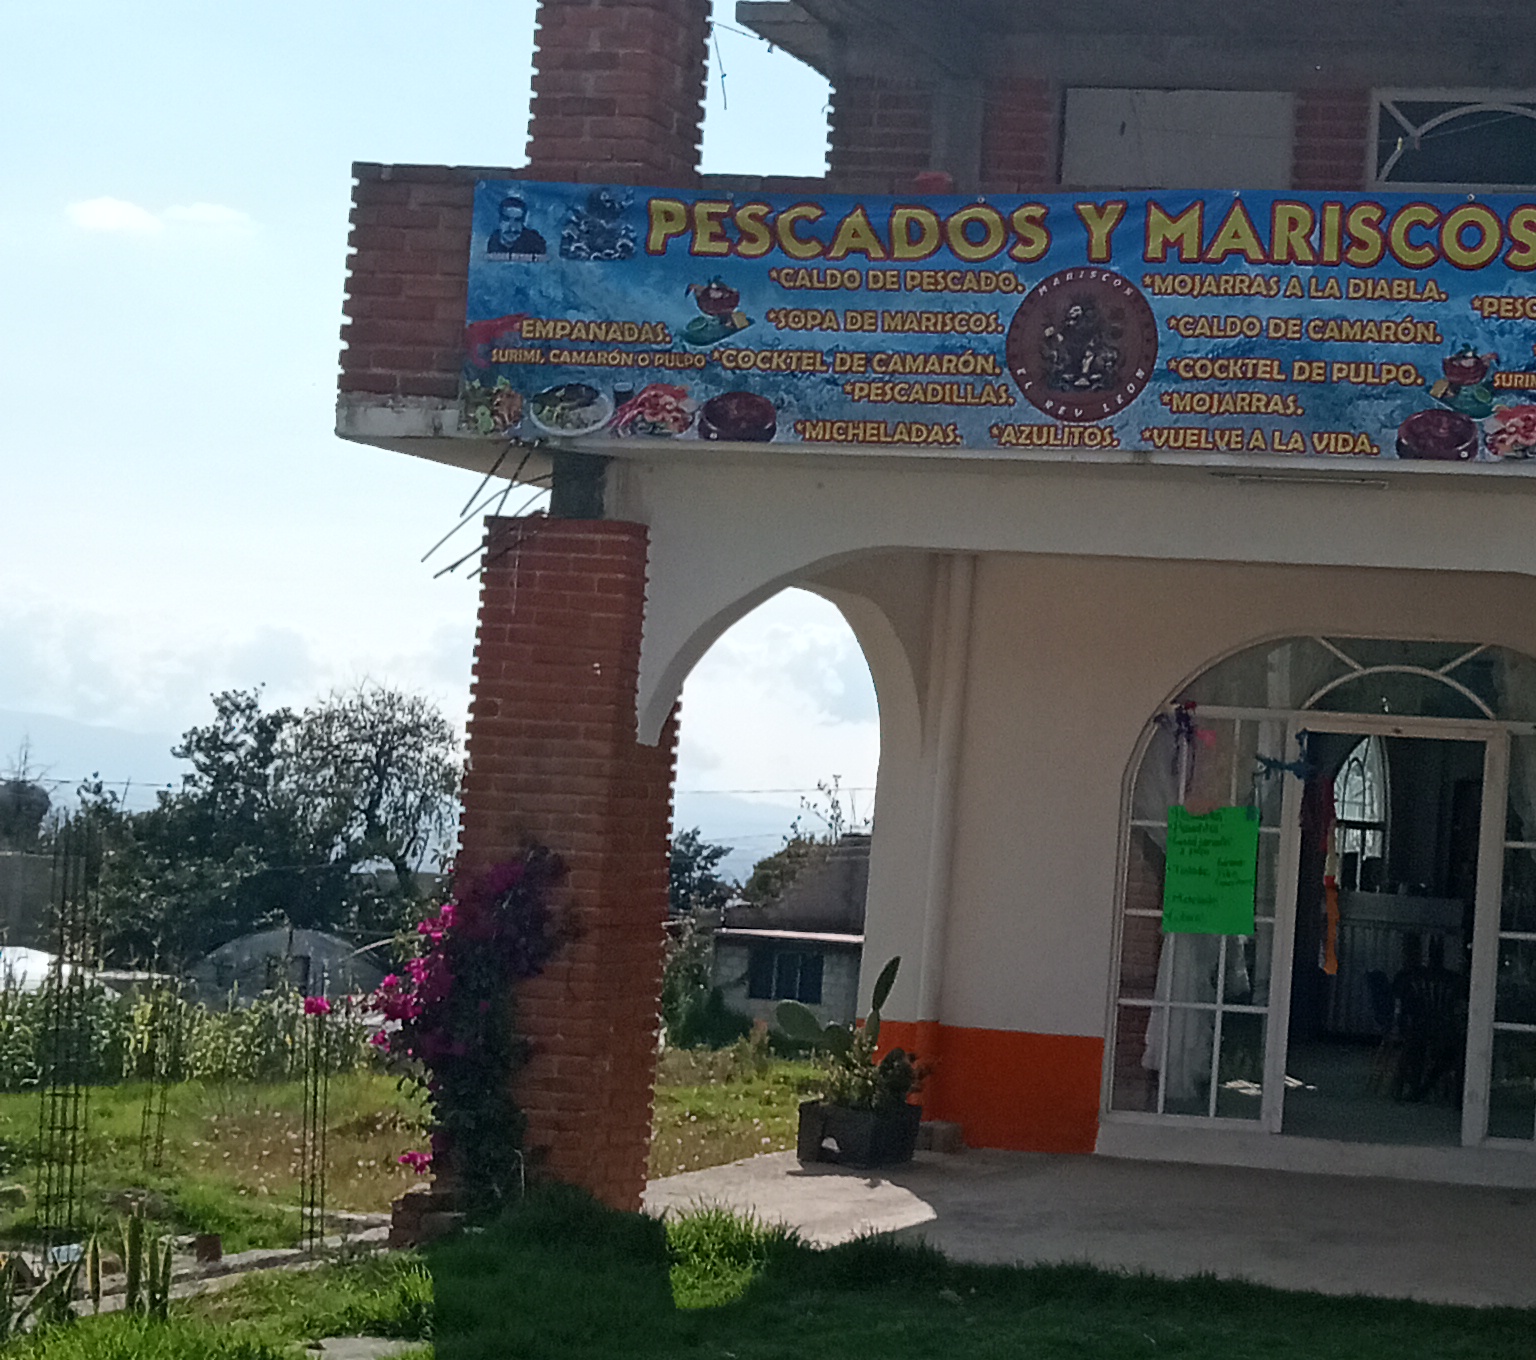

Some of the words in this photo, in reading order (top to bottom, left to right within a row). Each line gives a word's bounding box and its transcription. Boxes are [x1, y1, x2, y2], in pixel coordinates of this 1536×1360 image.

[646, 198, 1053, 262] PESCADOS
[1074, 201, 1128, 262] Y
[867, 270, 900, 290] DE
[905, 270, 1025, 293] PESCADO.
[1284, 276, 1304, 298] A
[1309, 277, 1343, 298] LA
[1348, 278, 1449, 301] DIABLA.
[844, 311, 878, 331] DE
[882, 311, 1005, 334] MARISCOS.
[1267, 319, 1302, 340] DE
[1307, 316, 1444, 344] CAMARÓN.
[491, 348, 546, 364] SURIMI,
[549, 348, 635, 367] CAMARÓN
[637, 353, 651, 367] O
[653, 353, 707, 370] PULPO
[833, 352, 869, 373] DE
[872, 349, 1003, 376] CAMARÓN.
[1292, 360, 1327, 383] DE
[1331, 363, 1425, 386] PULPO.
[1249, 430, 1267, 450] A
[1272, 431, 1305, 452] LA
[1311, 432, 1380, 454] VIDA.
